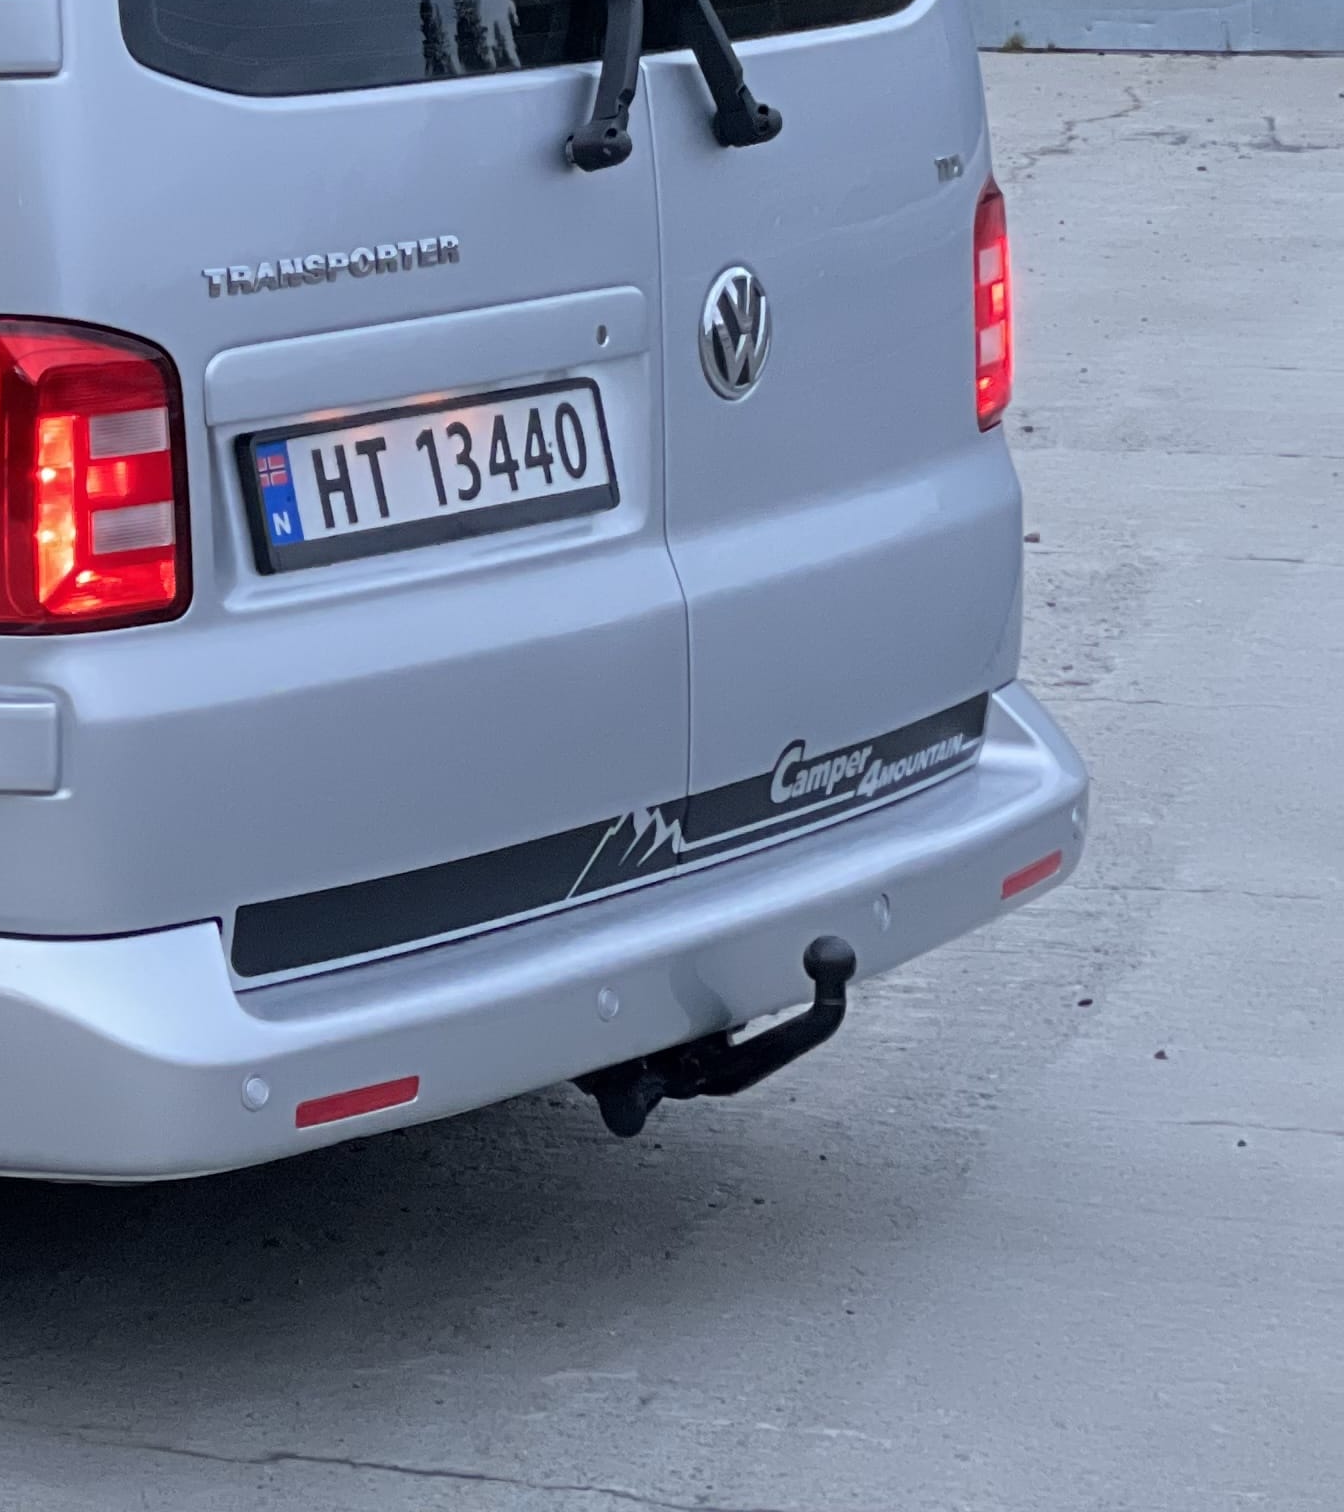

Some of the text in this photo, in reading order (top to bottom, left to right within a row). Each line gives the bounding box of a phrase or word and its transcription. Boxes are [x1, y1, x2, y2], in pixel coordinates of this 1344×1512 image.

[201, 235, 460, 298] TRANSPORTER
[311, 402, 588, 529] HT 13440
[272, 511, 291, 536] N
[770, 746, 873, 804] Camper
